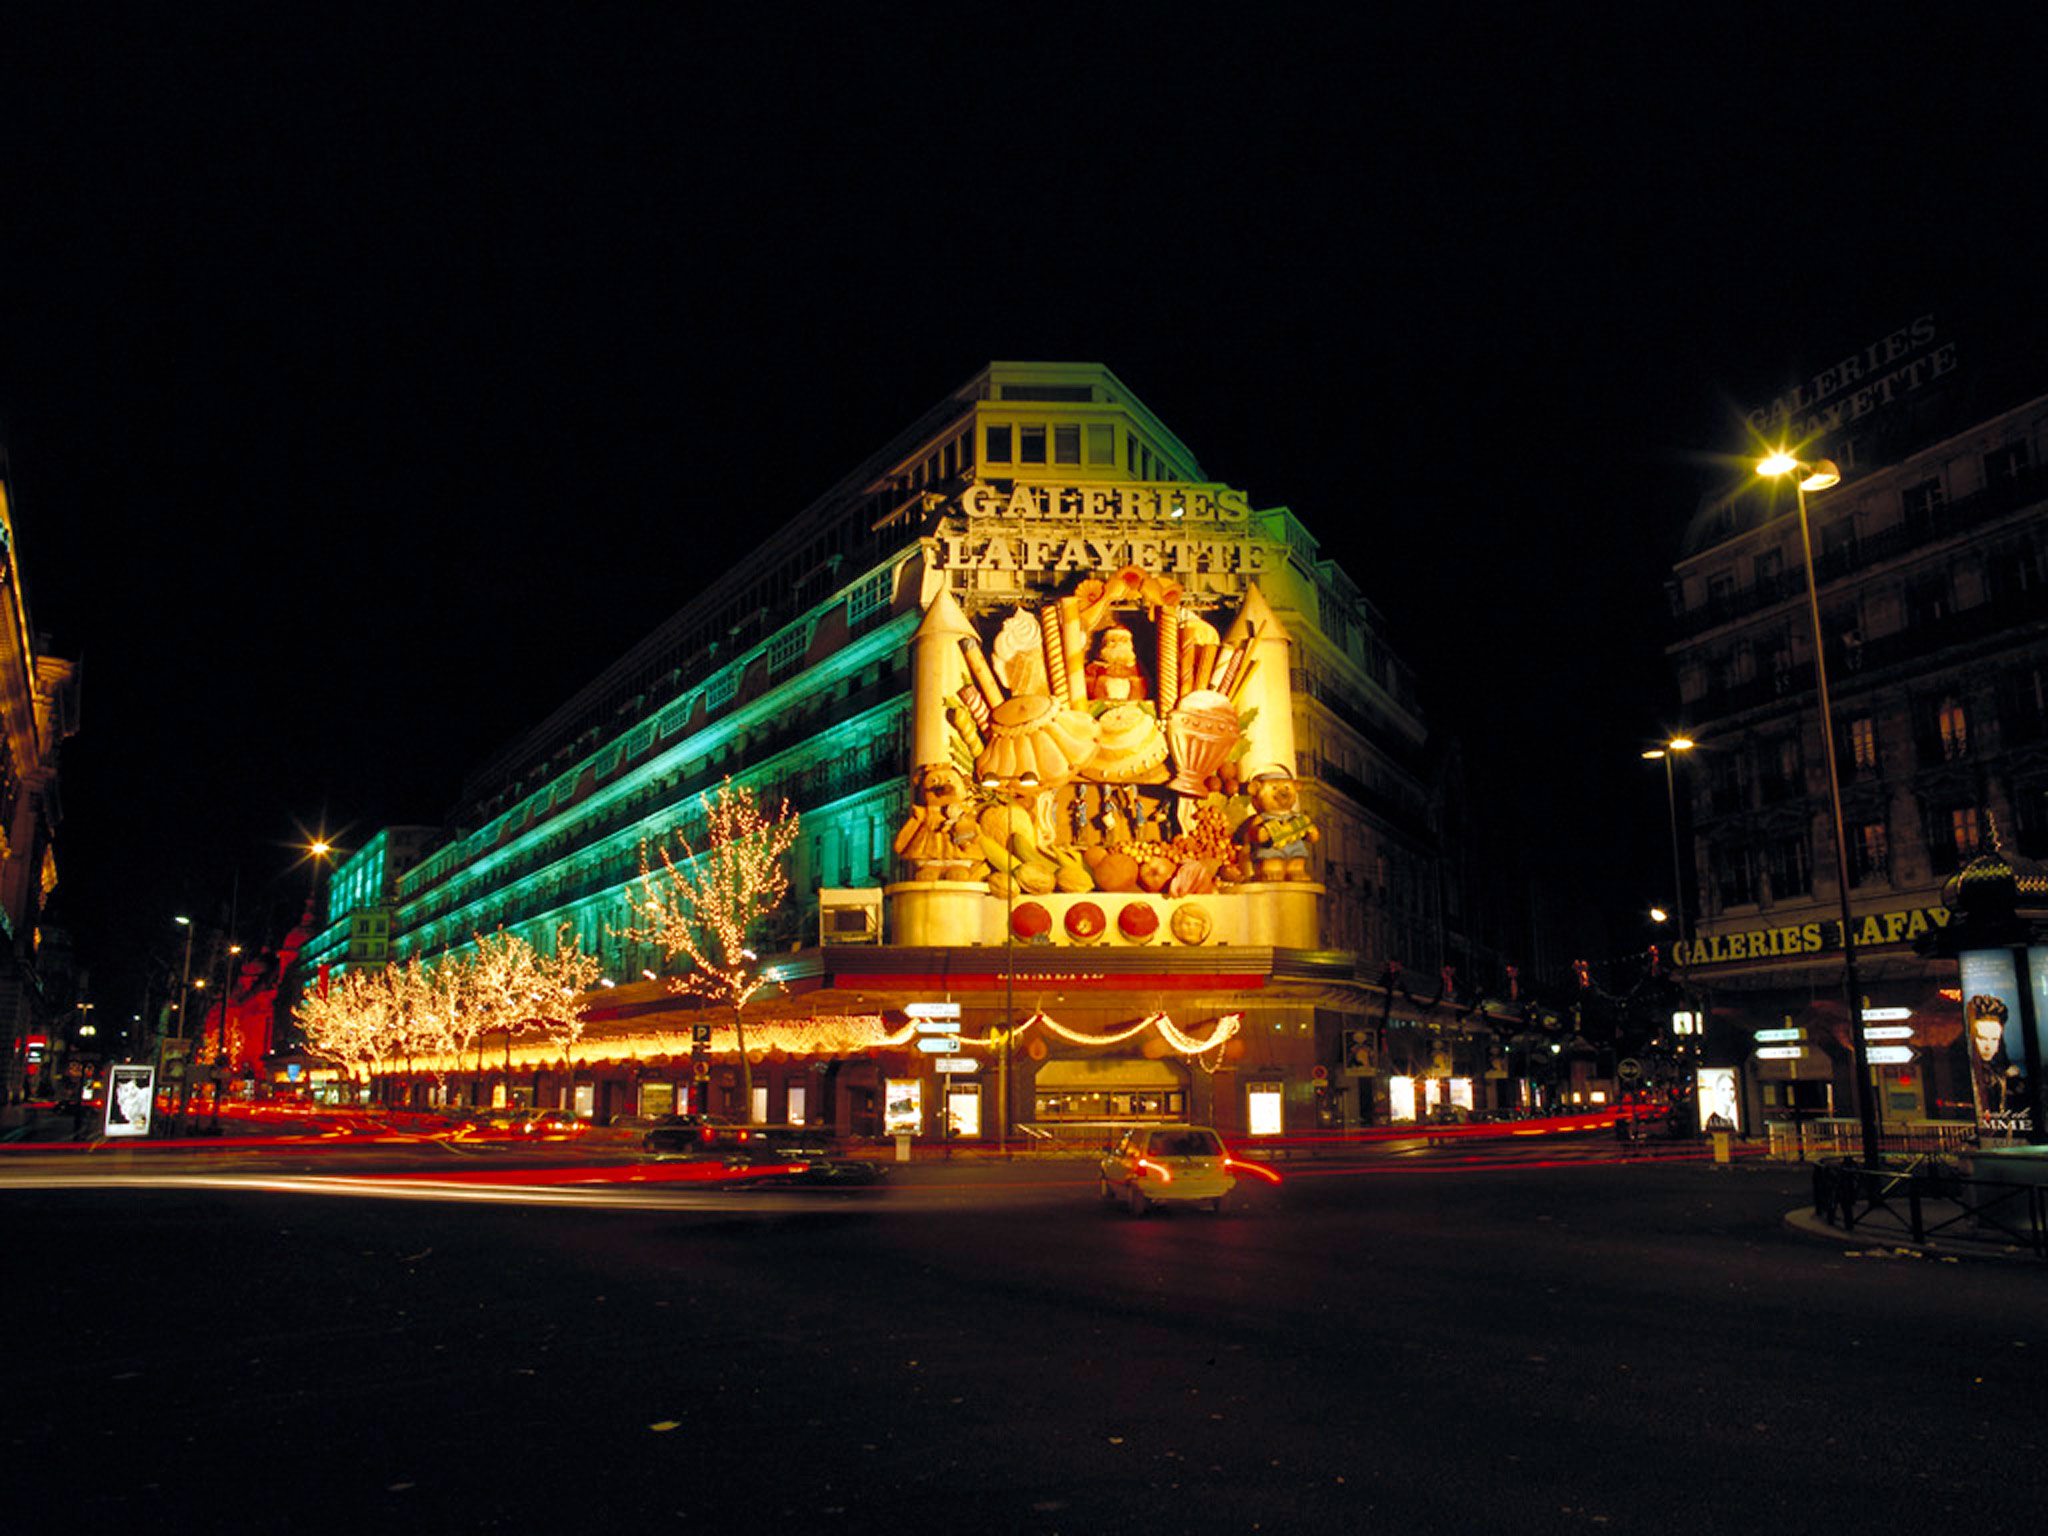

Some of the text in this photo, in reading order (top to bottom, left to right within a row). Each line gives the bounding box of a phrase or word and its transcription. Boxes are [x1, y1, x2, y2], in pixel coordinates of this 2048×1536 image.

[962, 485, 1248, 522] GALERIES
[943, 536, 1268, 573] LAFAYETTE
[1671, 923, 1823, 966] GALERIES
